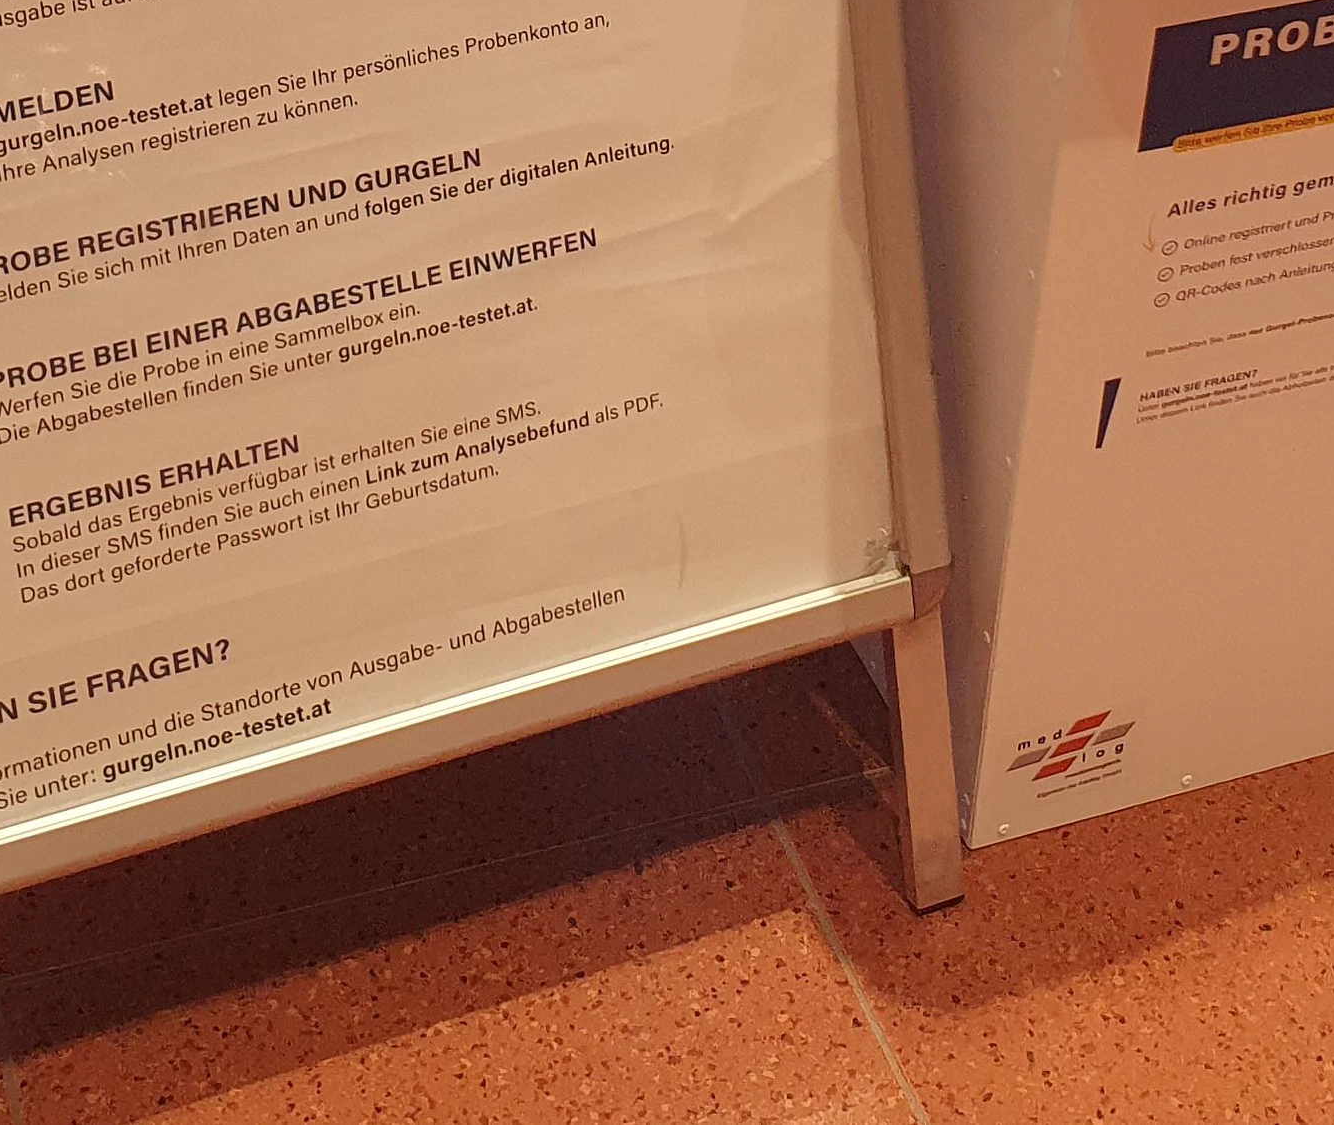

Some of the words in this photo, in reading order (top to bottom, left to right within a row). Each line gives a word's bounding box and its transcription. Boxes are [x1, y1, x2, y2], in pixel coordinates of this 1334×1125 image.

[78, 192, 279, 257] REGISTRIEREN
[288, 179, 346, 208] UND
[355, 148, 481, 192] GURGELN
[1167, 198, 1216, 218] Alles
[1223, 184, 1287, 207] richtig
[1184, 234, 1226, 249] Online
[1229, 219, 1292, 240] registriert
[1294, 212, 1319, 227] und
[1179, 259, 1225, 276] Proben
[1230, 252, 1253, 265] fest
[93, 338, 137, 367] BEI
[146, 317, 228, 354] EINER
[236, 264, 442, 333] ABGABESTELLE
[449, 227, 596, 280] EINWERFEN
[1175, 281, 1241, 301] QR-Codes
[1245, 272, 1275, 287] nach
[37, 389, 177, 435] Abgabestellen
[182, 373, 243, 398] finden
[249, 362, 278, 381] Sie
[284, 350, 332, 372] unter
[338, 297, 537, 363] gurgeln.noe-testet.at.
[1140, 385, 1180, 402] HABEN
[1183, 381, 1201, 392] SIE
[1204, 369, 1257, 388] FRAGEN?
[9, 474, 151, 527] ERGEBNIS
[159, 434, 299, 489] ERHALTEN
[28, 680, 78, 713] SIE
[86, 639, 229, 698] FRAGEN?
[34, 770, 96, 798] unter:
[103, 698, 331, 783] gurgeln.noe-testet.at
[1018, 729, 1063, 751] med
[1082, 743, 1124, 762] log
